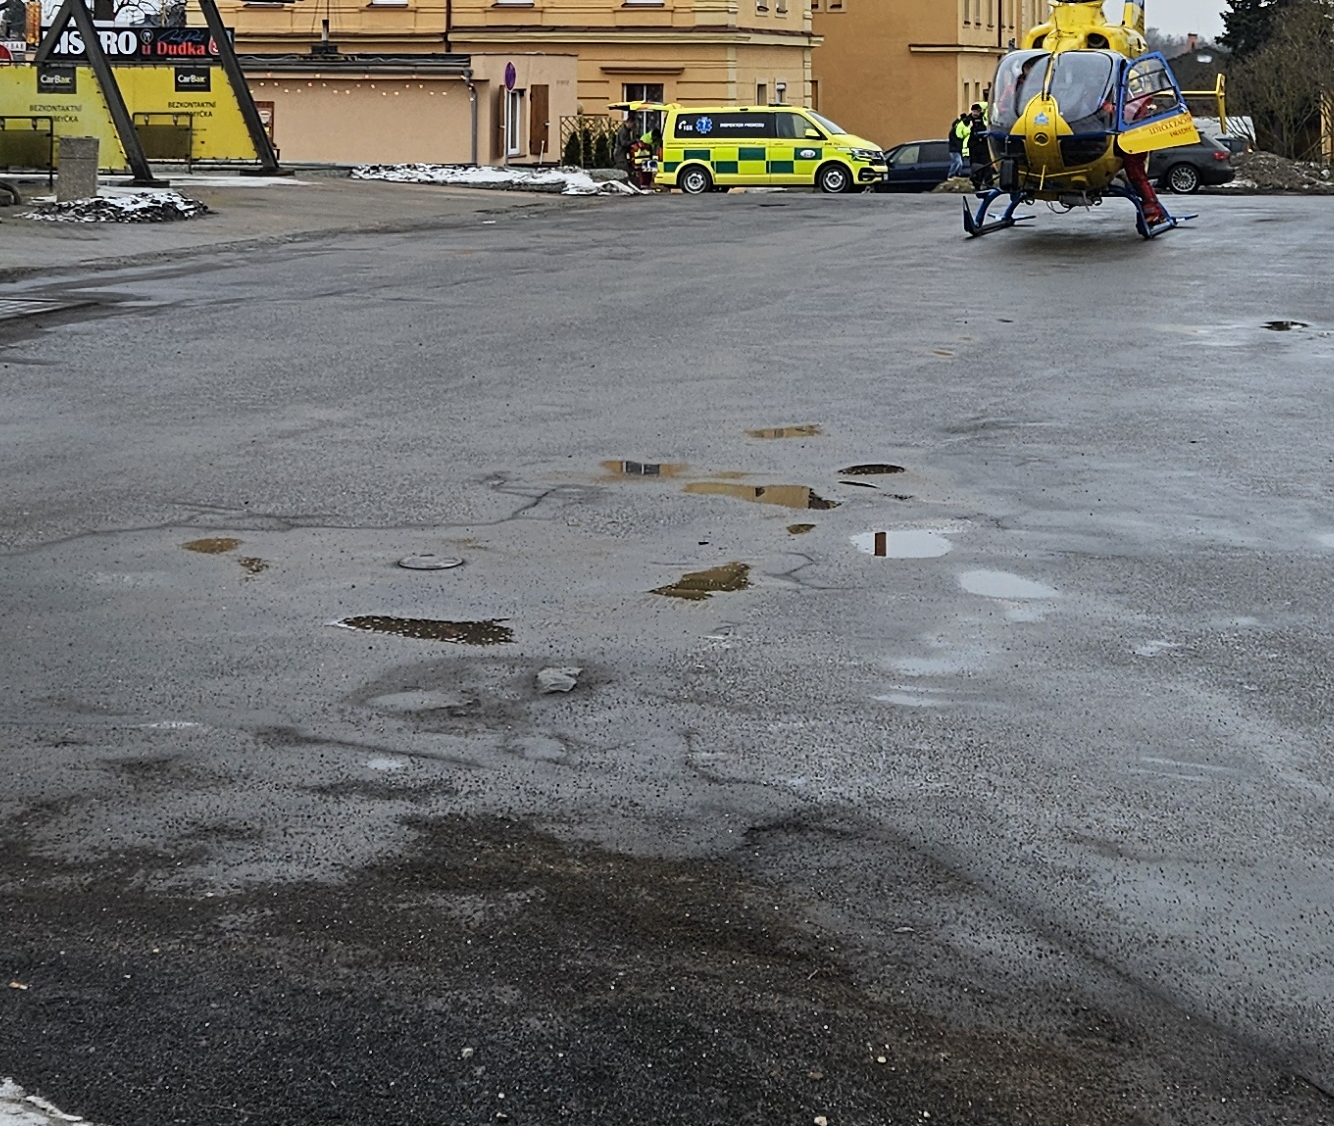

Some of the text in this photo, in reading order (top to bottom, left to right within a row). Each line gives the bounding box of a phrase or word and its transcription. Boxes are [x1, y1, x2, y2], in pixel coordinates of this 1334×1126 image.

[42, 31, 138, 55] ISRO
[141, 41, 206, 55] u Dudka
